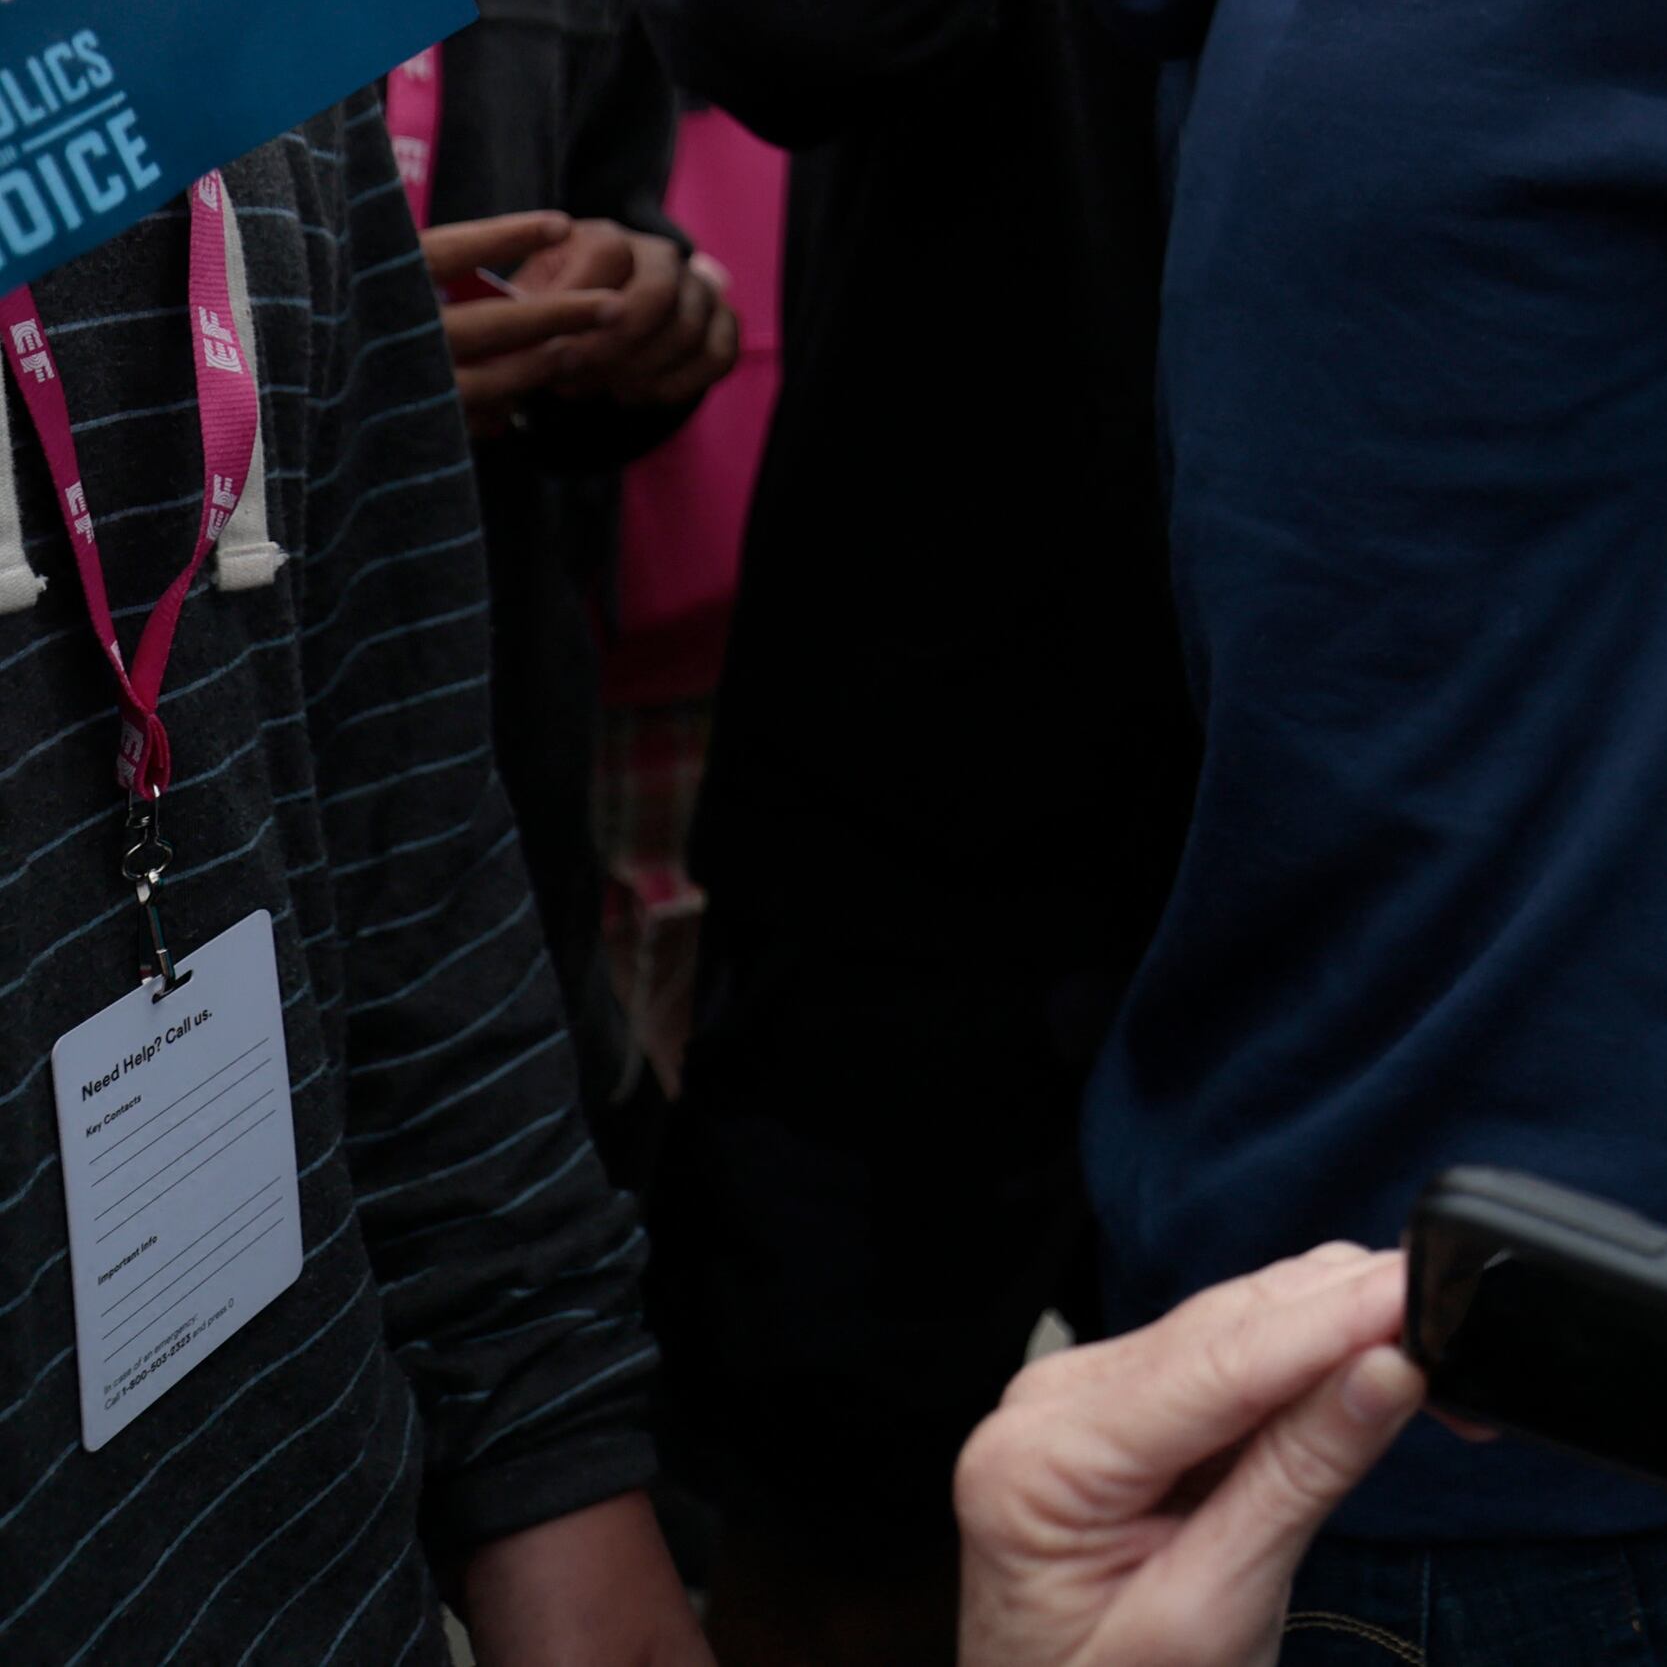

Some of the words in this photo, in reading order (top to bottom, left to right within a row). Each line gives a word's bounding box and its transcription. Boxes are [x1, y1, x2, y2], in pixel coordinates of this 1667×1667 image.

[0, 107, 162, 270] OICE
[81, 1064, 121, 1103] Need
[123, 1036, 162, 1074] Help?
[165, 1016, 192, 1045] Call
[194, 1008, 213, 1027] us.
[85, 1122, 103, 1139] Key
[103, 1094, 142, 1126] Contacts
[97, 1246, 140, 1286] Important
[140, 1234, 158, 1253] Info
